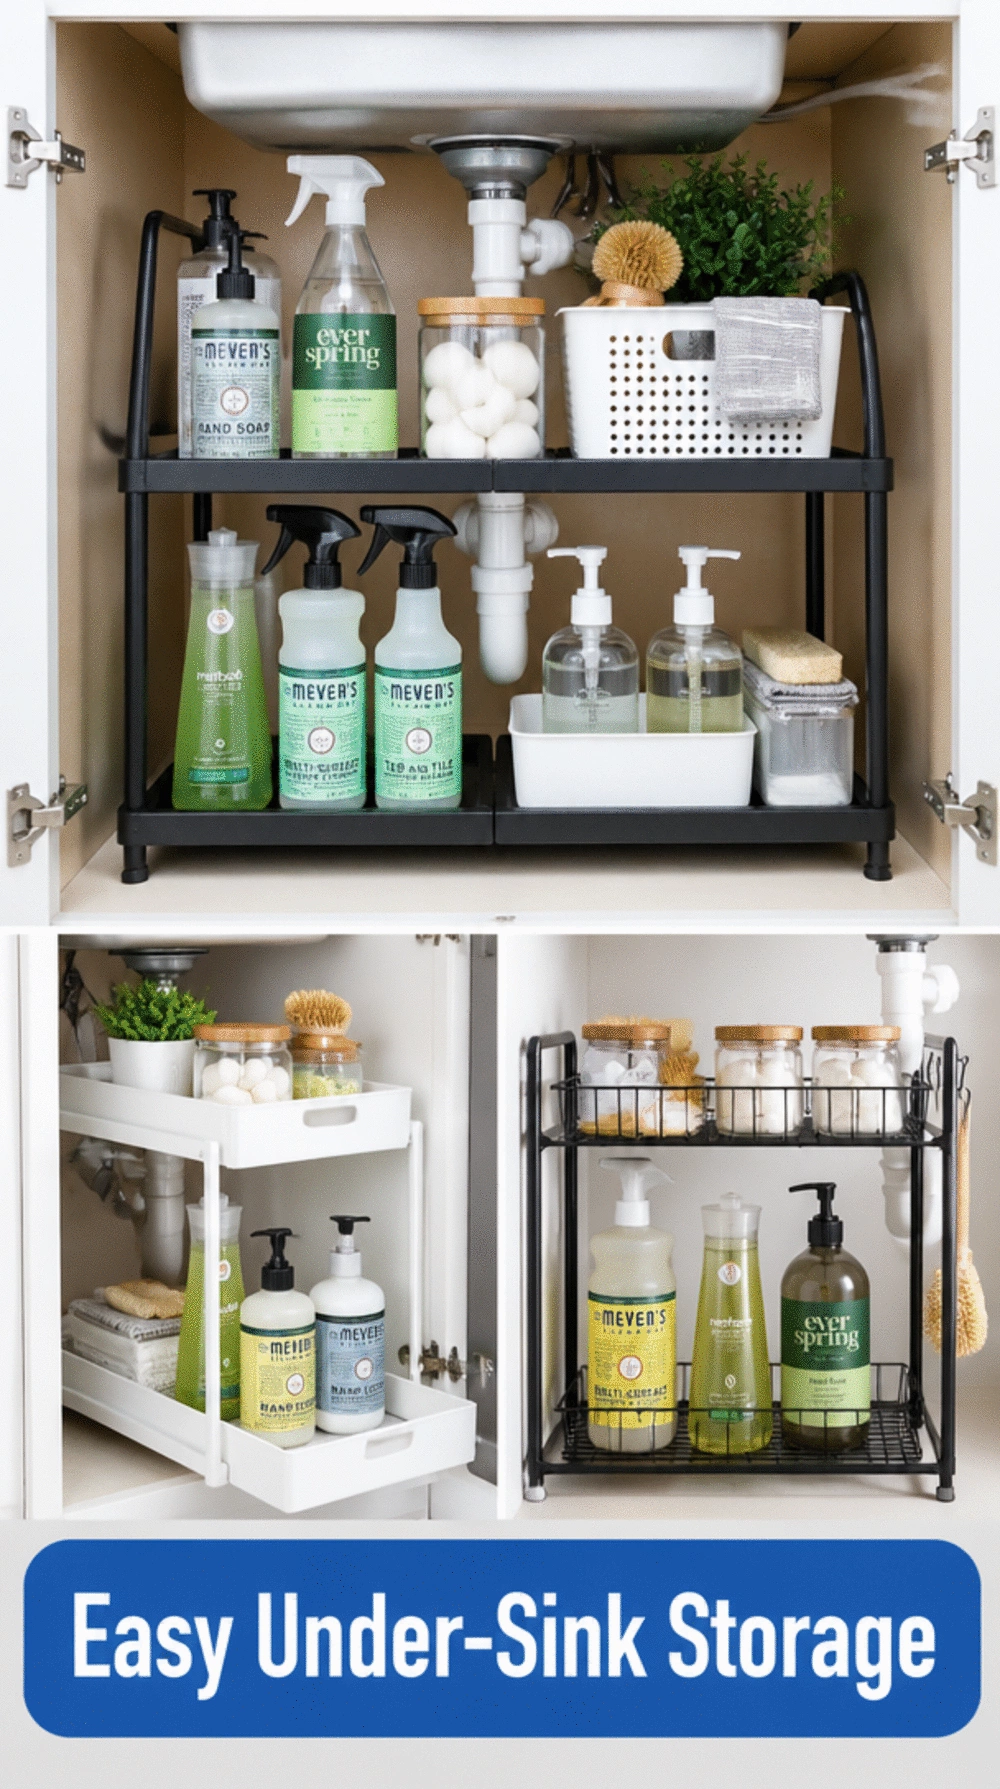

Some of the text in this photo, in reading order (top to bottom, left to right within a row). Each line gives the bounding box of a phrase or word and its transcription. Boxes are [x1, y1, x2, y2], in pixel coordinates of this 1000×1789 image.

[316, 328, 370, 346] ever
[305, 343, 380, 370] spring
[804, 1315, 851, 1332] ever
[794, 1329, 860, 1353] spring
